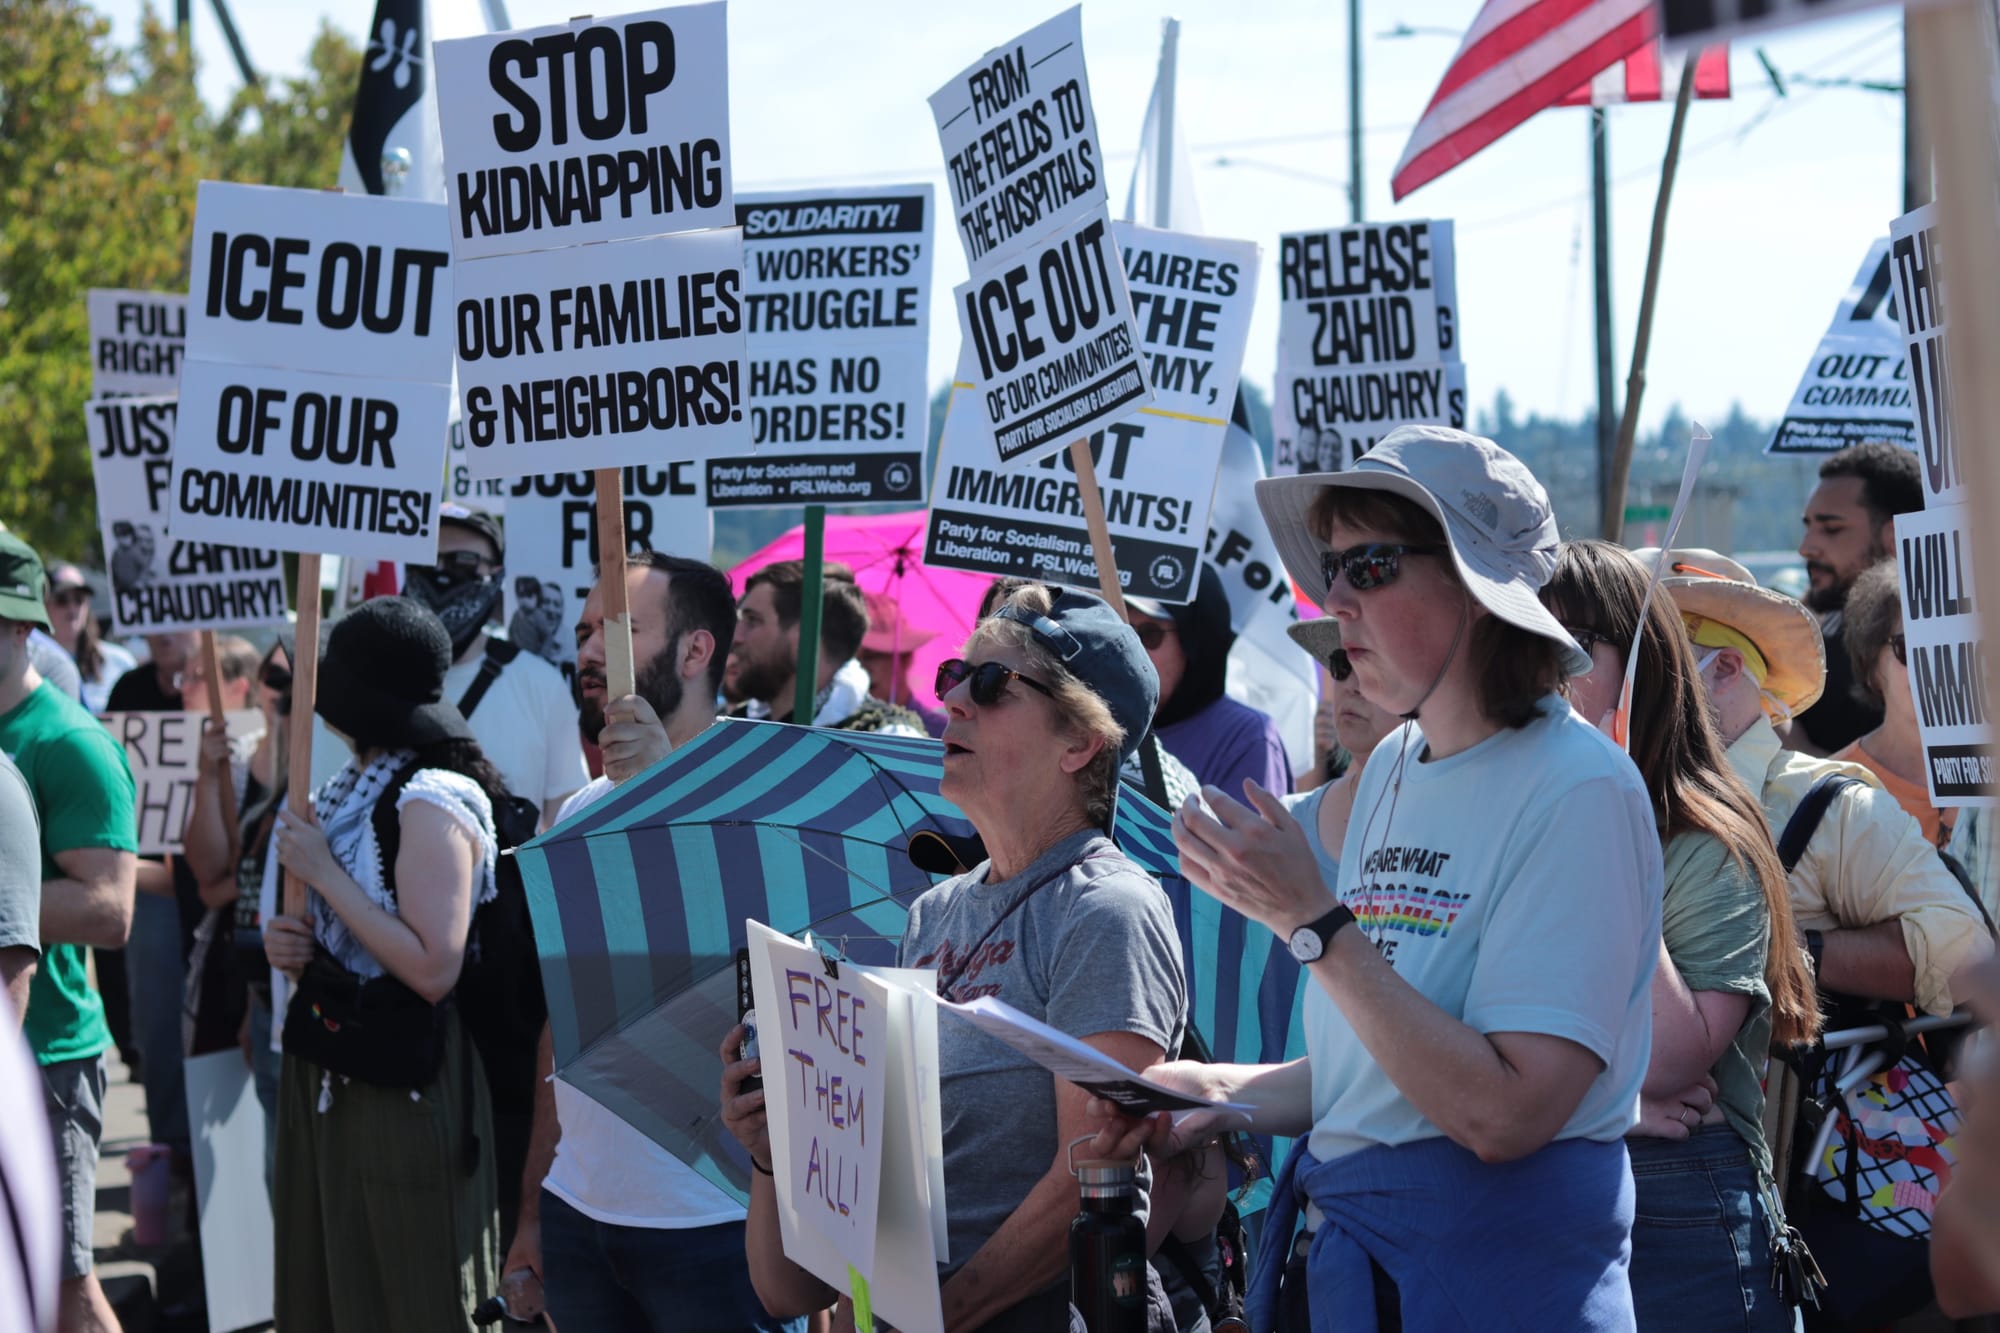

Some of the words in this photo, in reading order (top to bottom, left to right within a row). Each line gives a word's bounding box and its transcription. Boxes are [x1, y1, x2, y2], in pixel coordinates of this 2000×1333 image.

[488, 20, 676, 153] STOP
[968, 45, 1031, 126] FROM
[949, 139, 987, 207] THE
[980, 98, 1053, 187] FIELDS
[1051, 78, 1085, 140] TO
[456, 138, 723, 239] KIDNAPPING
[745, 203, 901, 235] SOLIDARITY!
[961, 200, 997, 262] THE
[991, 138, 1097, 243] HOSPITALS
[206, 231, 310, 325] ICE
[316, 241, 450, 337] OUT
[966, 264, 1046, 381] ICE
[1039, 218, 1116, 344] OUT
[1123, 246, 1240, 298] AIRES
[1281, 223, 1431, 300] RELEASE
[457, 293, 544, 362] OUR
[550, 269, 742, 352] FAMILIES
[1307, 296, 1416, 367] ZAHID
[466, 386, 498, 448] &
[502, 360, 743, 444] NEIGHBORS!
[750, 357, 818, 398] HAS
[829, 356, 880, 394] NO
[986, 387, 1007, 424] OF
[1005, 371, 1039, 415] OUR
[1037, 320, 1134, 400] COMMUNITIES!
[1292, 367, 1442, 426] CHAUDHRY
[1802, 384, 1912, 408] COMMU
[1816, 353, 1889, 381] OUT
[216, 384, 287, 456] OF
[290, 391, 400, 469] OUR
[998, 428, 1029, 456] PARTY
[1026, 420, 1045, 442] FOR
[1043, 398, 1092, 434] SOCIALISM
[1096, 367, 1142, 407] LIBERATION
[179, 467, 433, 538] COMMUNITIES!
[711, 465, 745, 482] Party
[746, 465, 764, 479] for
[766, 462, 828, 479] Socialism
[828, 462, 856, 477] and
[711, 482, 773, 498] Liberation
[790, 480, 872, 497] PSLWeb.org
[934, 539, 1011, 565] Liberation
[1031, 552, 1132, 588] PSLWebrg
[938, 520, 977, 543] Party
[980, 525, 1004, 545] for
[1004, 529, 1081, 554] Socialism
[1902, 529, 1973, 621] WILL
[115, 578, 285, 626] CHAUDHRY!
[1932, 757, 1964, 785] PARTY
[1960, 756, 1983, 785] FOR
[1400, 846, 1451, 878] WHAT
[785, 967, 866, 1067] FREE
[787, 1048, 865, 1149] THEM
[805, 1135, 859, 1229] ALL!
